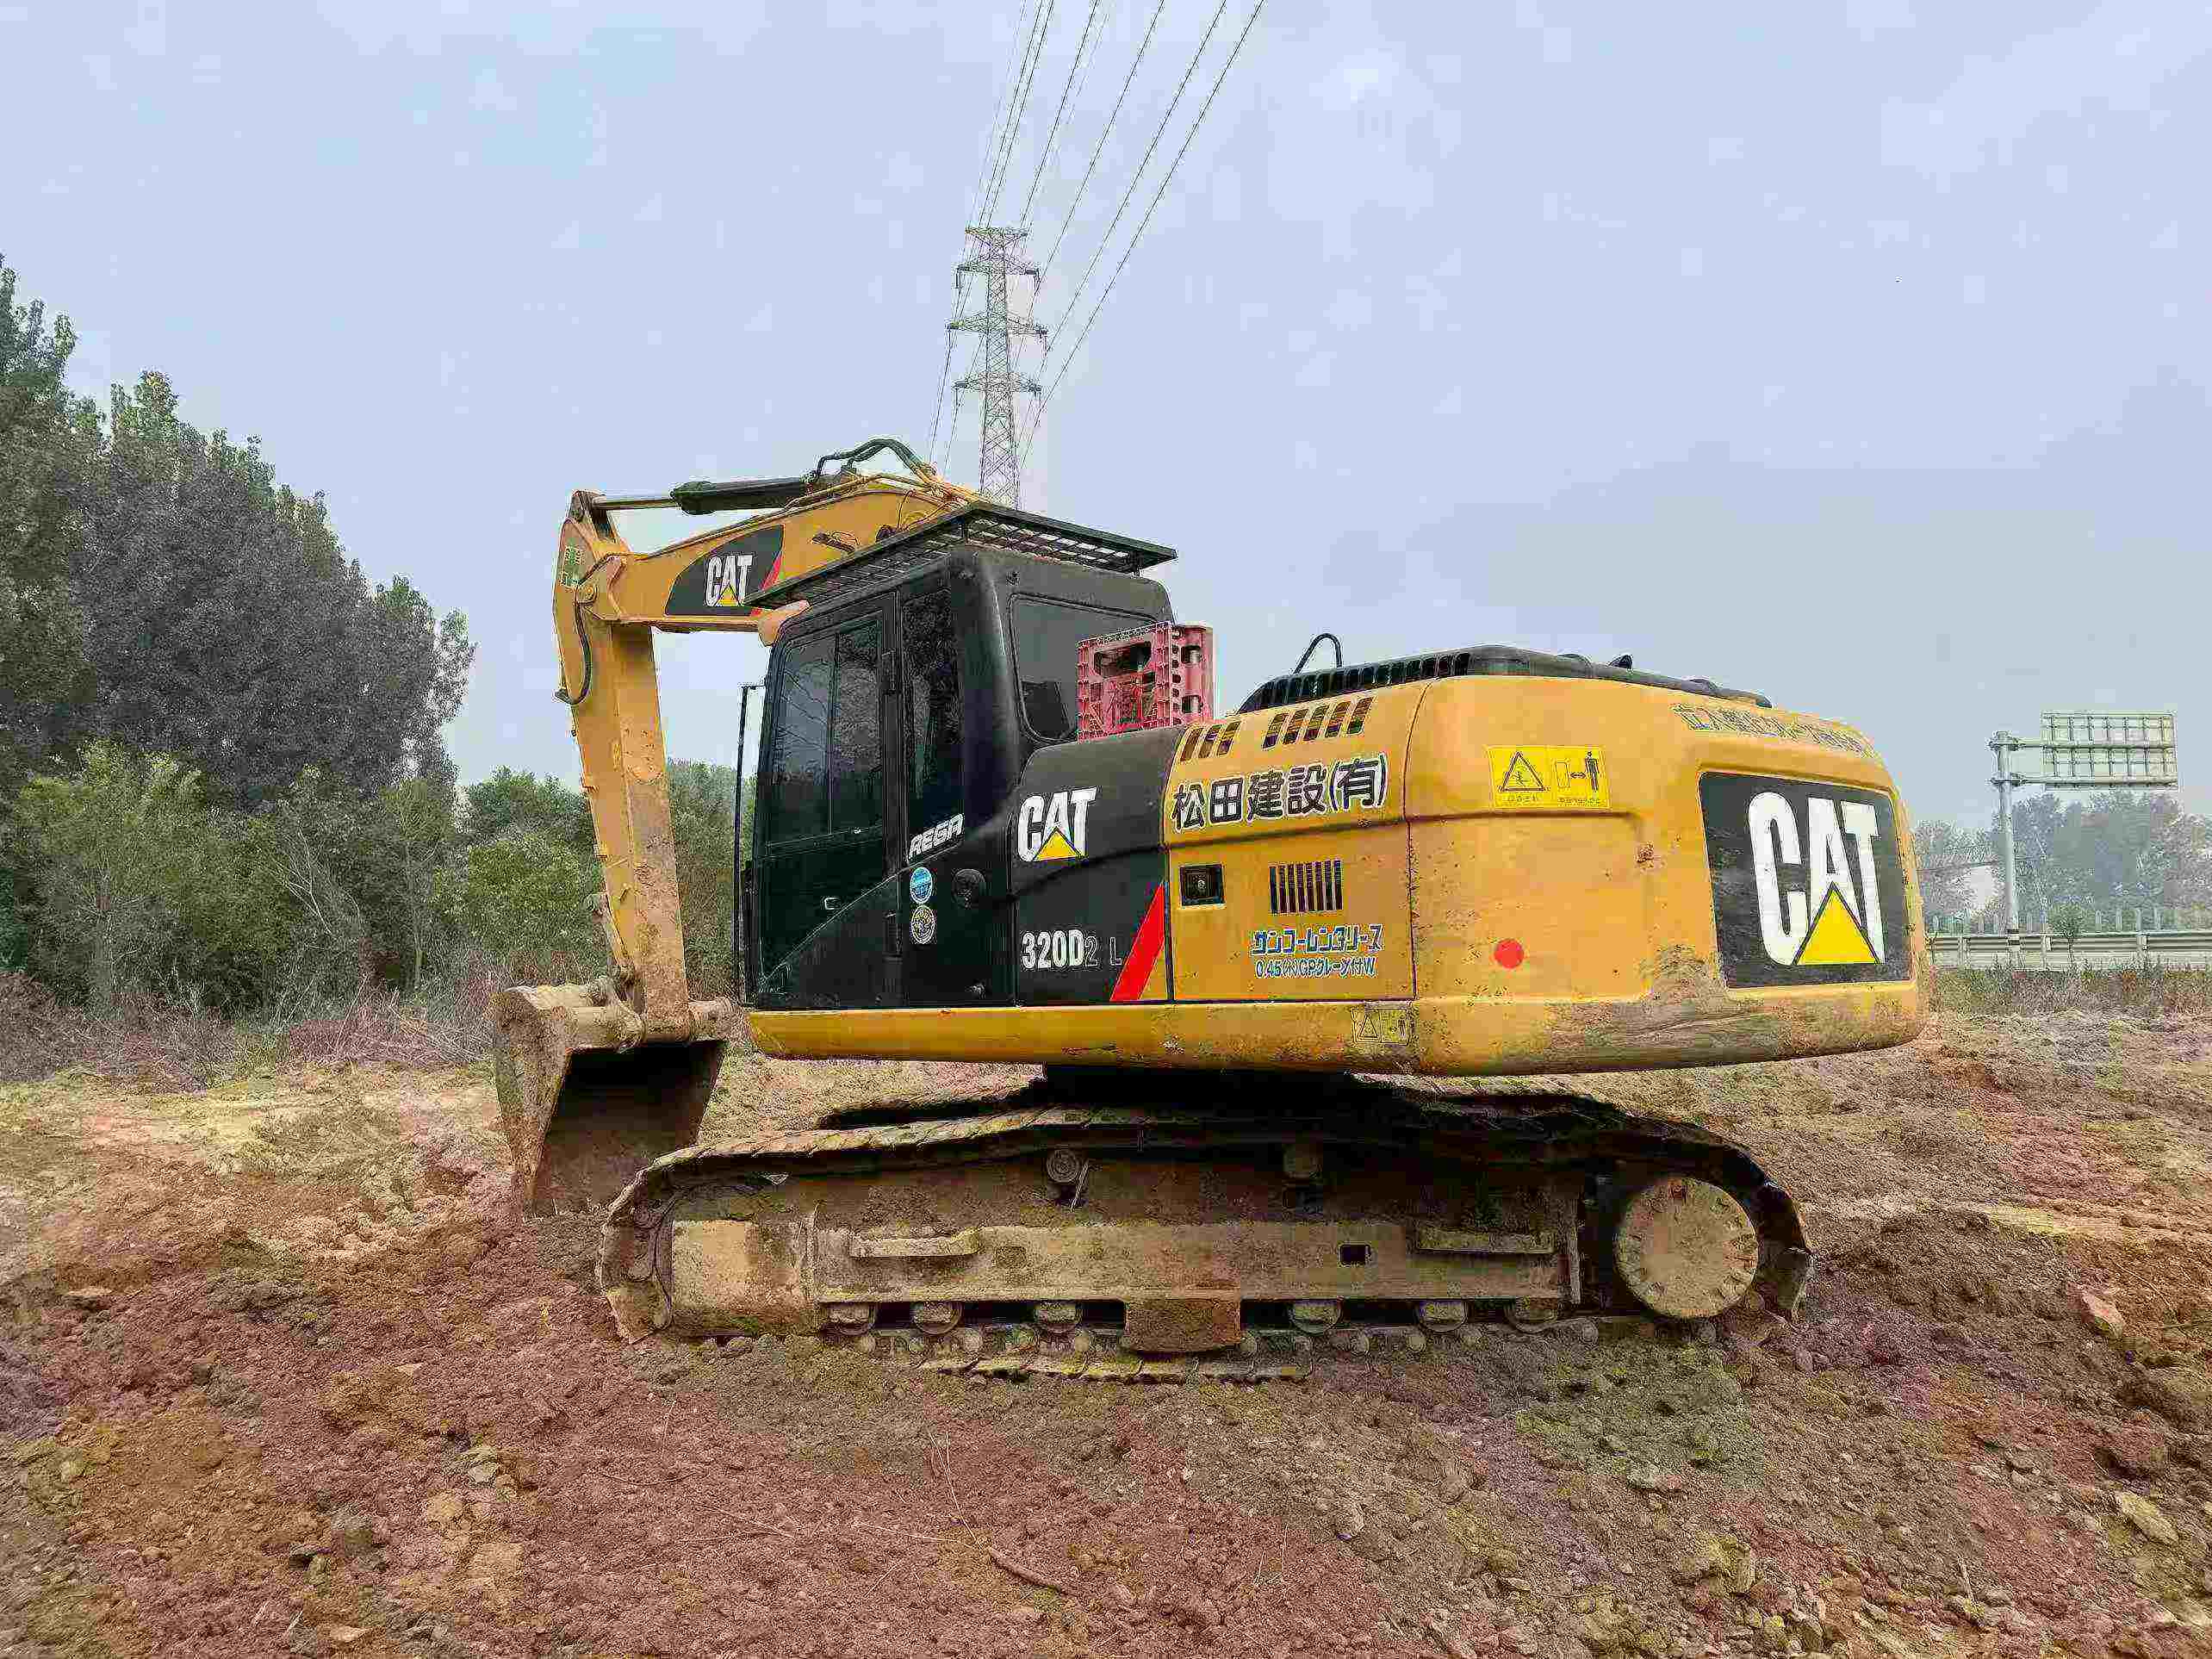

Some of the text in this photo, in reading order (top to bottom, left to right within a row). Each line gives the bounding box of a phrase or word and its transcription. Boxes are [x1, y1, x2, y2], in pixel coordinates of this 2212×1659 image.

[706, 555, 753, 607] CAT
[1017, 786, 1097, 862] CAT
[1171, 752, 1388, 831] 松田建設(有)
[909, 813, 964, 860] REGA
[1749, 791, 1886, 966] CAT
